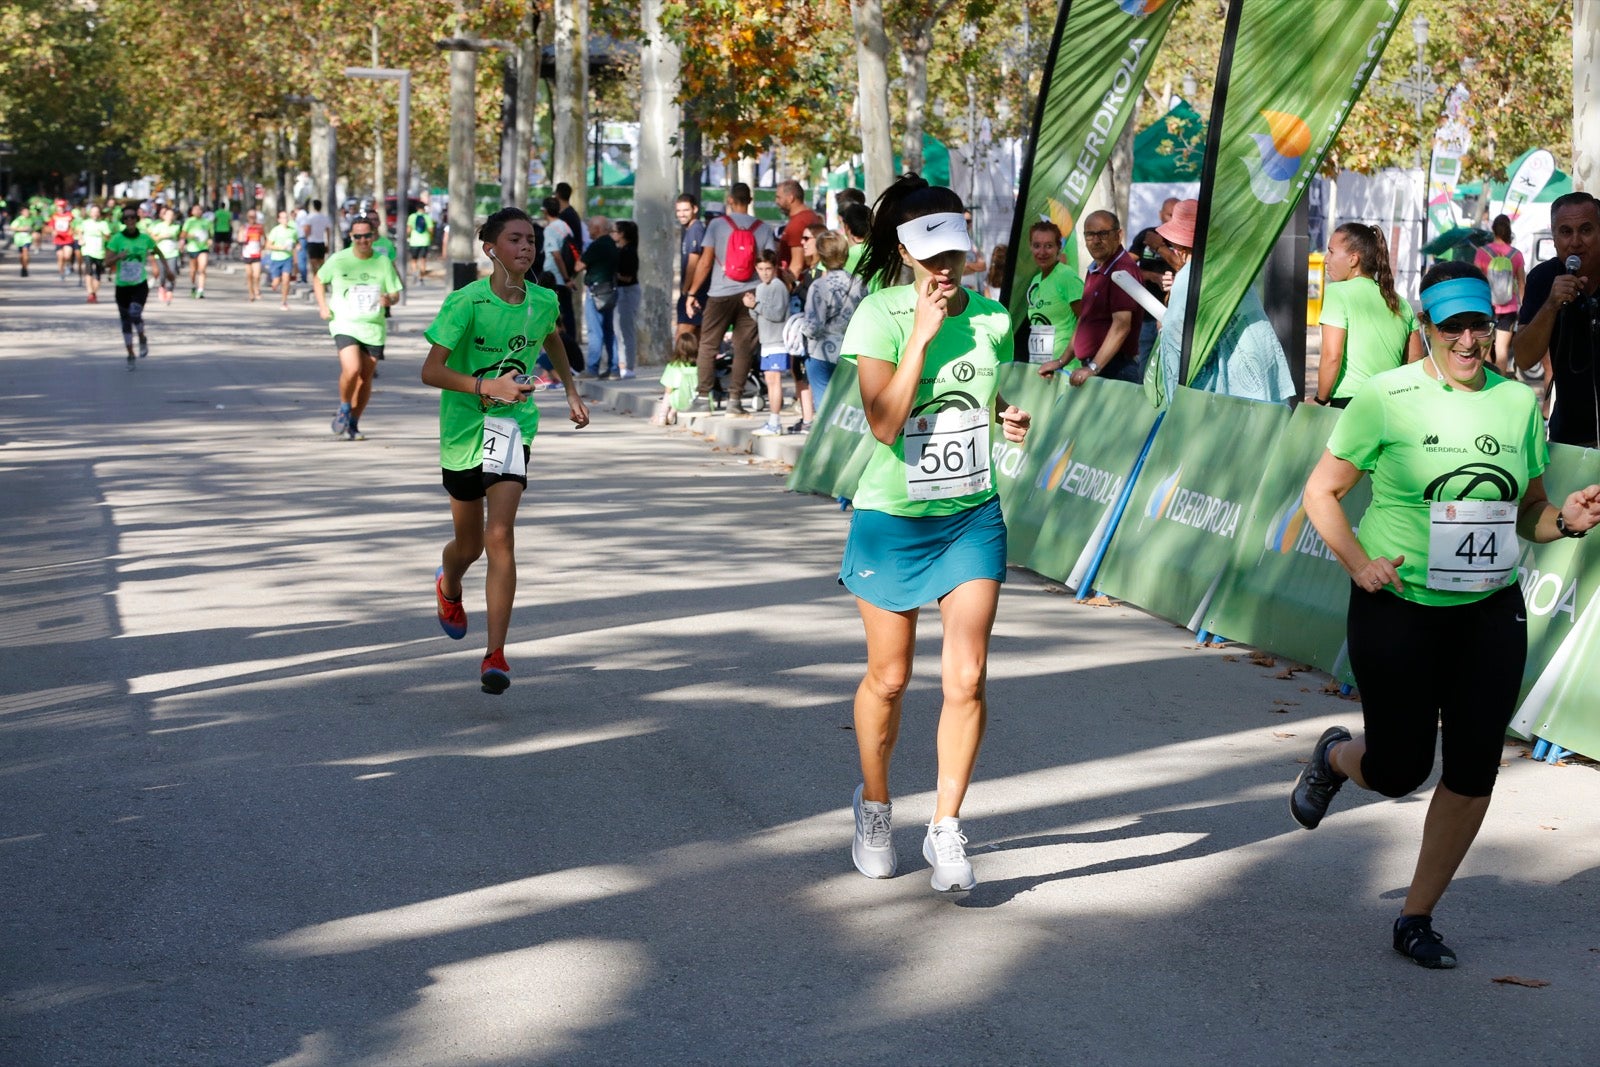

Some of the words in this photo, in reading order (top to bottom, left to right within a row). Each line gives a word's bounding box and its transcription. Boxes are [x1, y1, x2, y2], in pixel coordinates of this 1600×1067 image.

[1063, 38, 1149, 205] IBERDROLA
[920, 436, 977, 475] 561
[1426, 446, 1468, 454] IBERDROLA
[1165, 486, 1242, 539] IBERDROLA
[1455, 531, 1498, 565] 44
